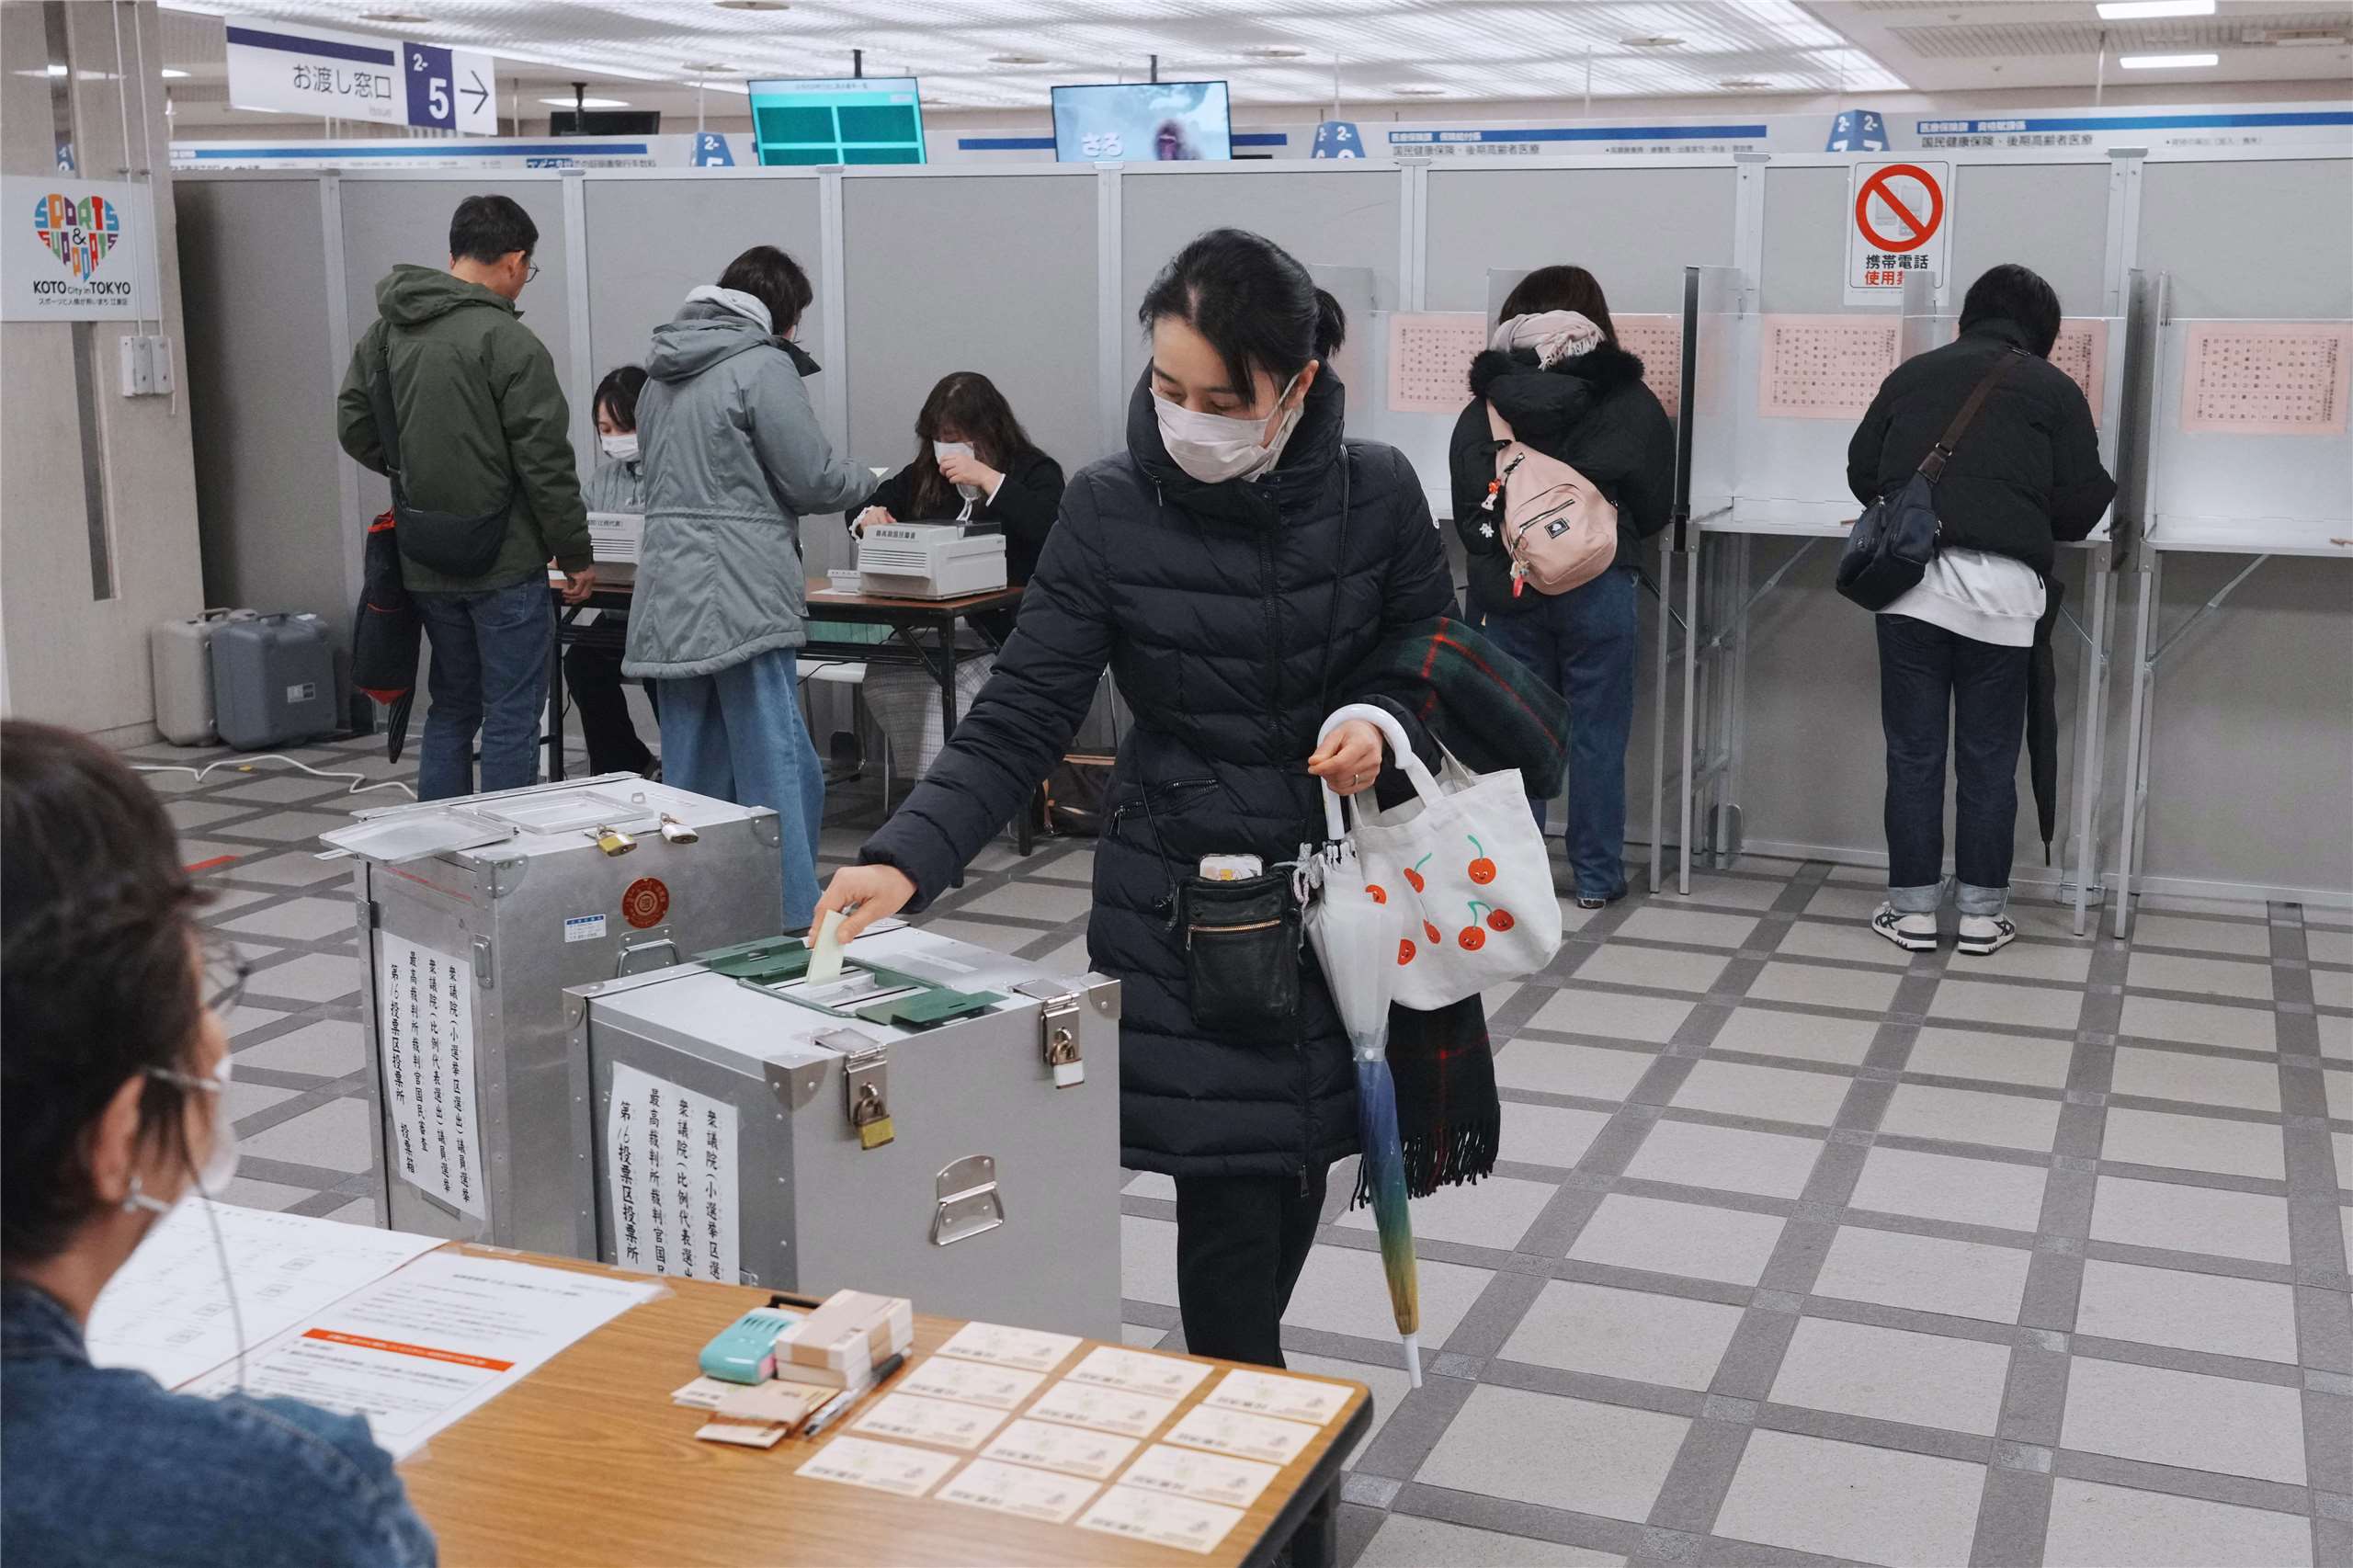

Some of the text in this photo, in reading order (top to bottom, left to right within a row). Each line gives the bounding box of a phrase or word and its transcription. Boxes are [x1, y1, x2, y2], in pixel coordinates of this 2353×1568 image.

[293, 63, 392, 100] お渡し窓口
[428, 77, 449, 119] 5
[73, 228, 86, 245] &
[1866, 255, 1929, 269] 携帯電話
[33, 280, 67, 294] KOTO
[89, 281, 131, 294] TOKYO
